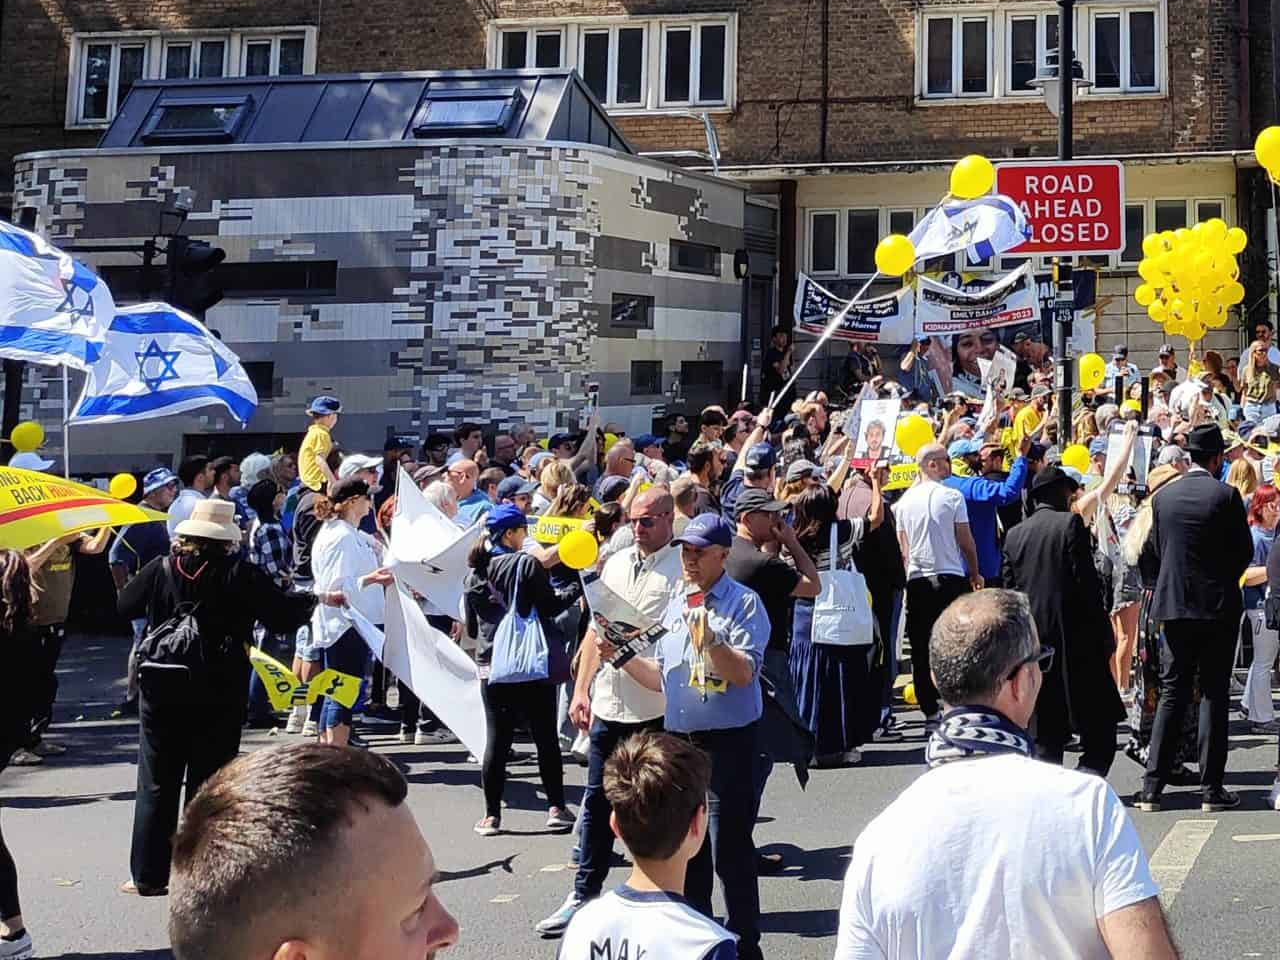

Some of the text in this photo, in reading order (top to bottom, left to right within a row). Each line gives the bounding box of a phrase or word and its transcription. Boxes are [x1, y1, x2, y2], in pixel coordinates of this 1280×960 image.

[1024, 174, 1094, 195] ROAD
[1018, 198, 1103, 219] AHEAD
[1028, 222, 1110, 244] LOSED
[1012, 309, 1032, 319] 2023
[0, 471, 20, 488] ING
[11, 485, 48, 505] BACK
[539, 522, 561, 536] ONE
